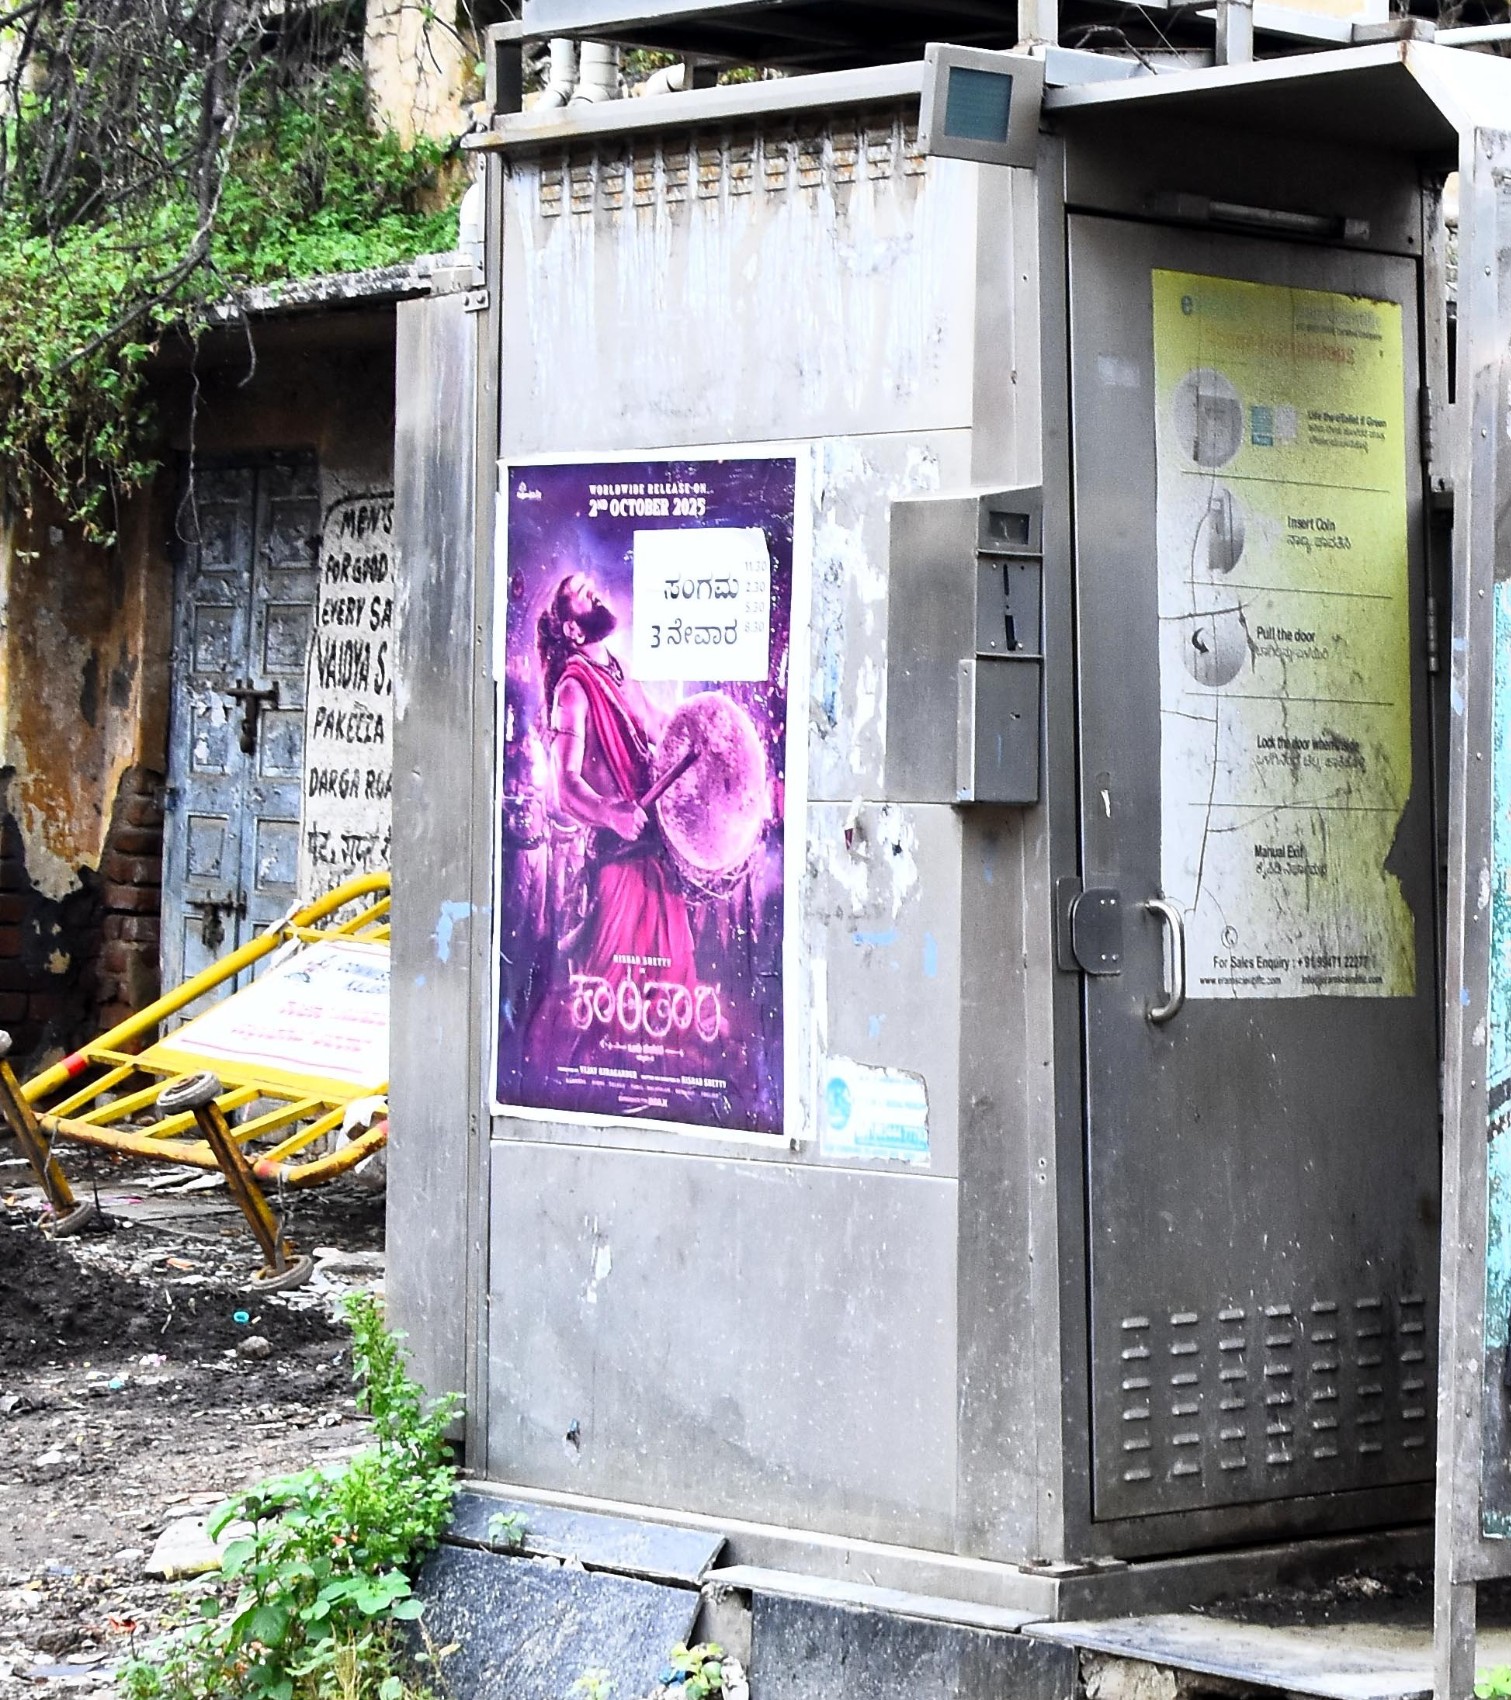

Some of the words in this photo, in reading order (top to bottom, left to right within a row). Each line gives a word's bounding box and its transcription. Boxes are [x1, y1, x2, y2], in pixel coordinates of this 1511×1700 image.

[588, 483, 645, 496] WORLDWIDE
[647, 482, 690, 495] RELEASE
[609, 497, 670, 517] OCTOBER
[672, 497, 706, 518] 2025
[1287, 515, 1314, 531] Insert
[1316, 517, 1336, 532] Coin
[663, 572, 740, 600] ಸಂಗಮ
[321, 596, 366, 628] EVERY
[650, 625, 661, 649] 3
[1256, 625, 1275, 640] Pull
[1276, 626, 1293, 641] the
[1294, 628, 1315, 643] door
[317, 636, 371, 692] VAIDYA
[1254, 844, 1286, 858] Manual
[1213, 955, 1228, 969] For
[1230, 955, 1254, 969] Sales
[1256, 955, 1290, 972] Enquiry
